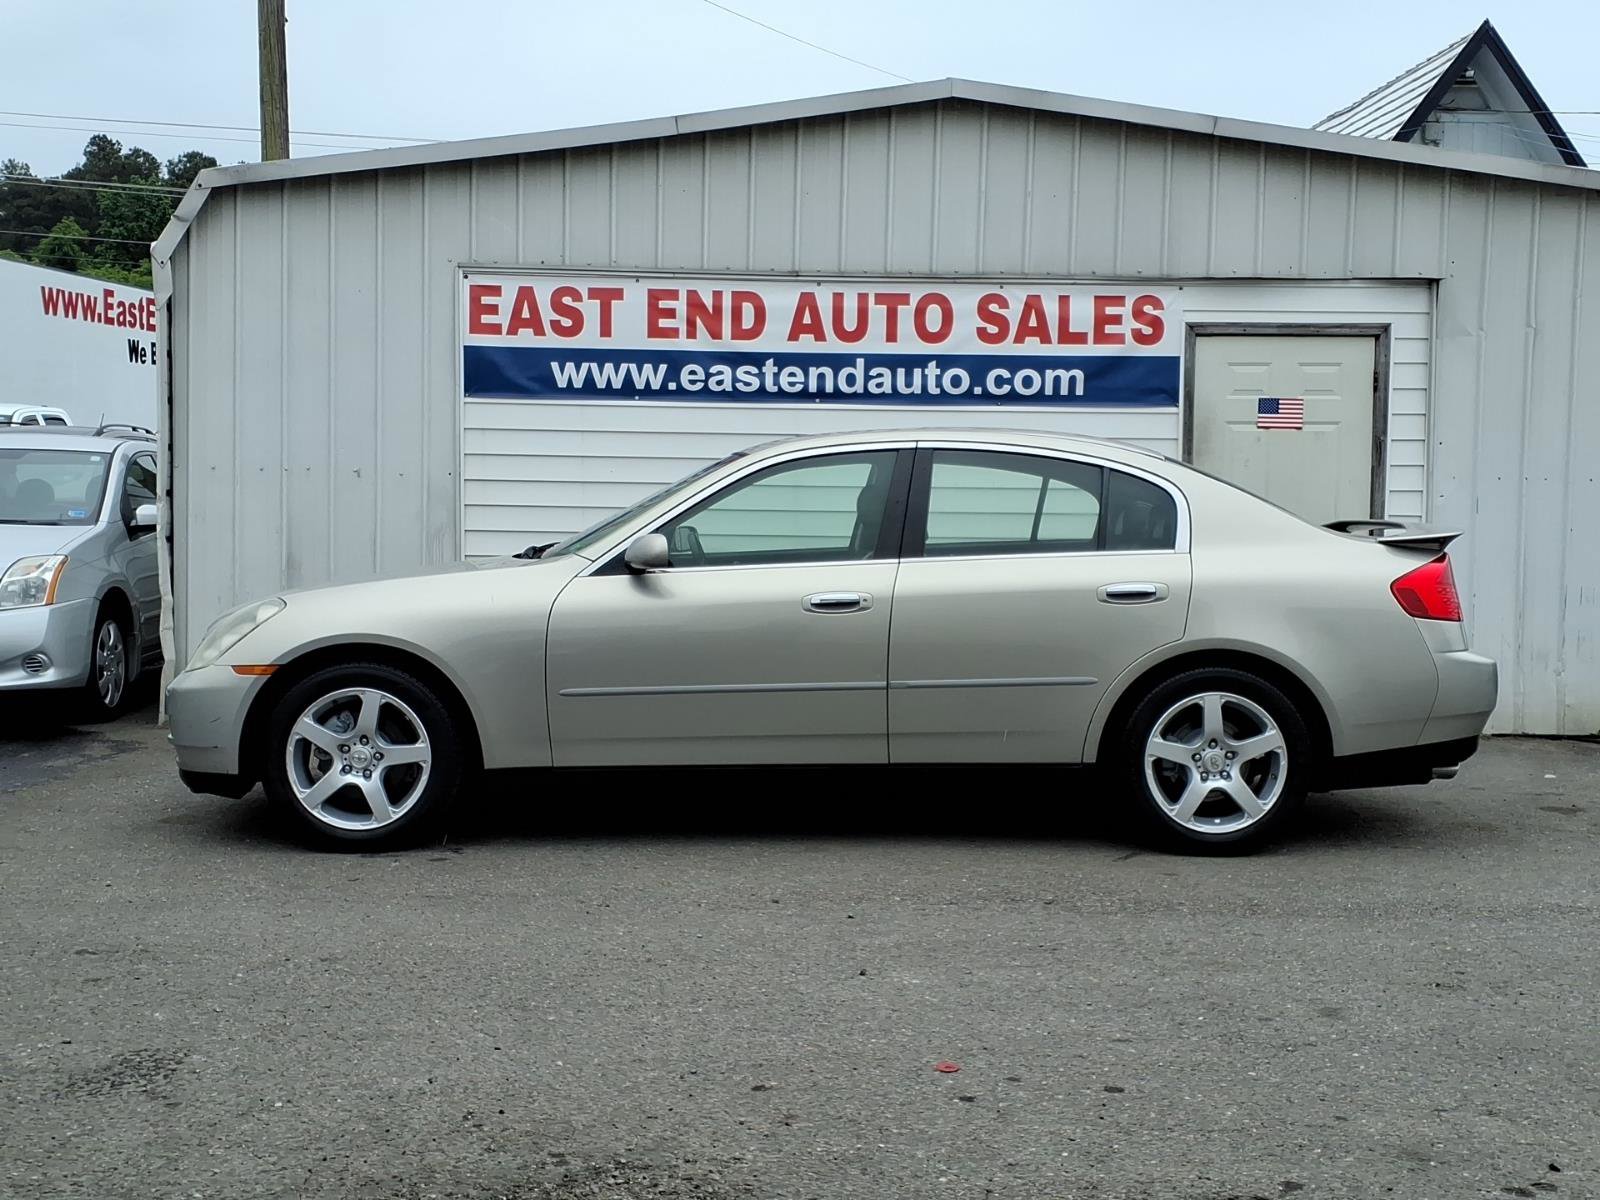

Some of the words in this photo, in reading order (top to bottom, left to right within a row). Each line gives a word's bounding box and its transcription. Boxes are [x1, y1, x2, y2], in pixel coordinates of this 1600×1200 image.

[469, 284, 624, 338] EAST
[647, 288, 767, 341] END
[787, 292, 954, 344] AUTO
[975, 294, 1165, 346] SALES
[127, 338, 147, 365] We
[550, 357, 1085, 396] www.eastendauto.com
